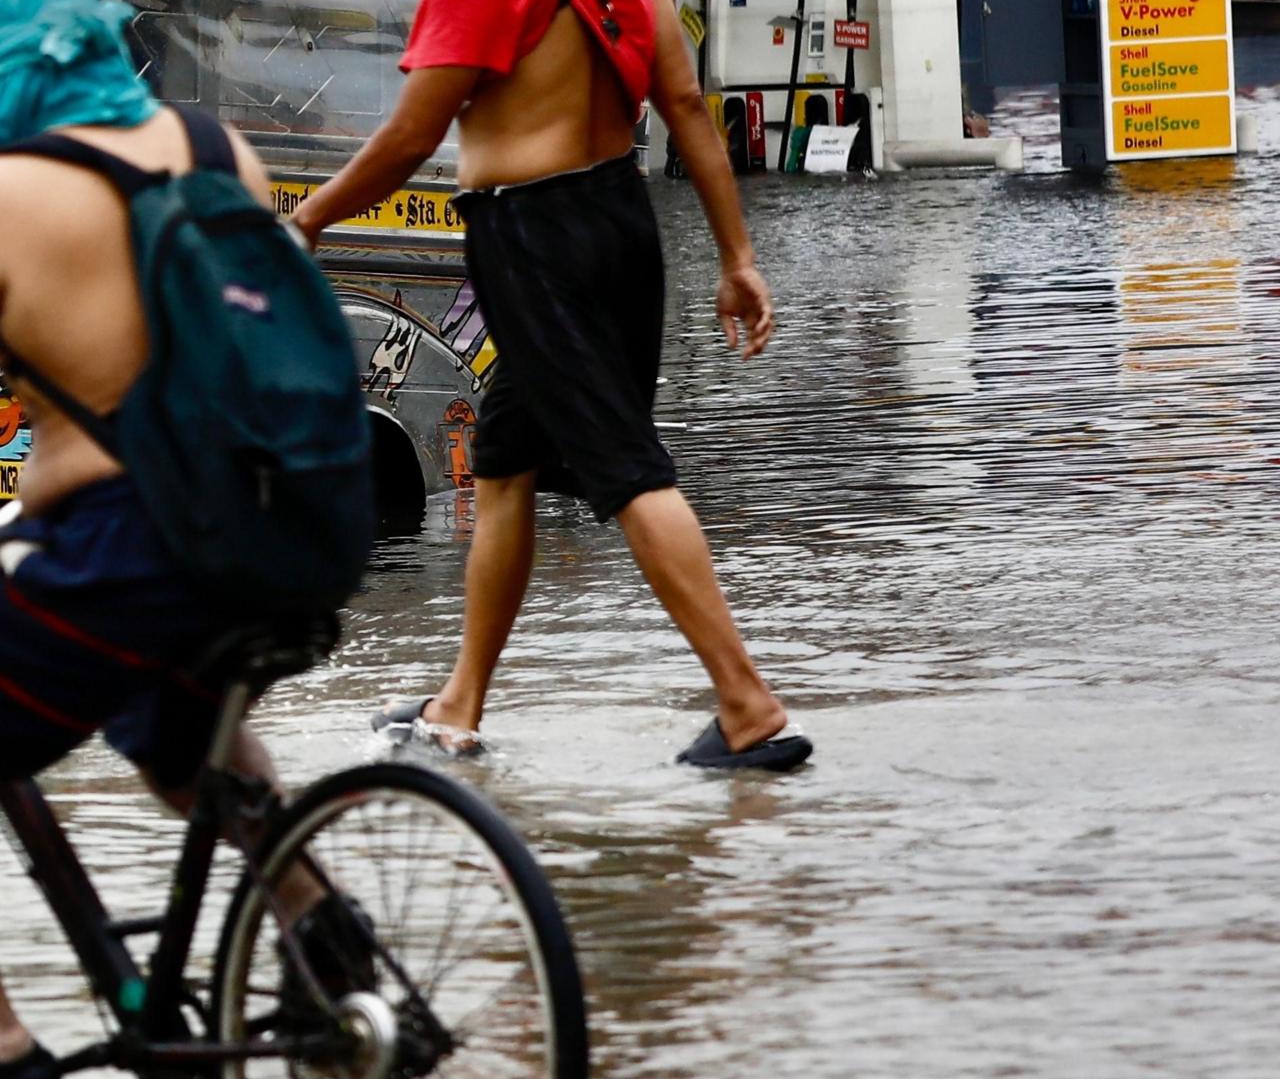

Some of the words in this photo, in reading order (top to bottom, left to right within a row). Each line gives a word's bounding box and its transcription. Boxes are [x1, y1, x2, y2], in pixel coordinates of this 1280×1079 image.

[1120, 4, 1195, 21] V-Power
[1120, 24, 1160, 38] Diesel
[1120, 47, 1148, 60] Shell
[1120, 62, 1199, 78] FuelSave
[1121, 80, 1177, 93] Gasoline
[1123, 103, 1152, 116] Shell
[1124, 116, 1201, 134] FuelSave
[1124, 136, 1163, 149] Diesel
[405, 193, 441, 228] Sta.
